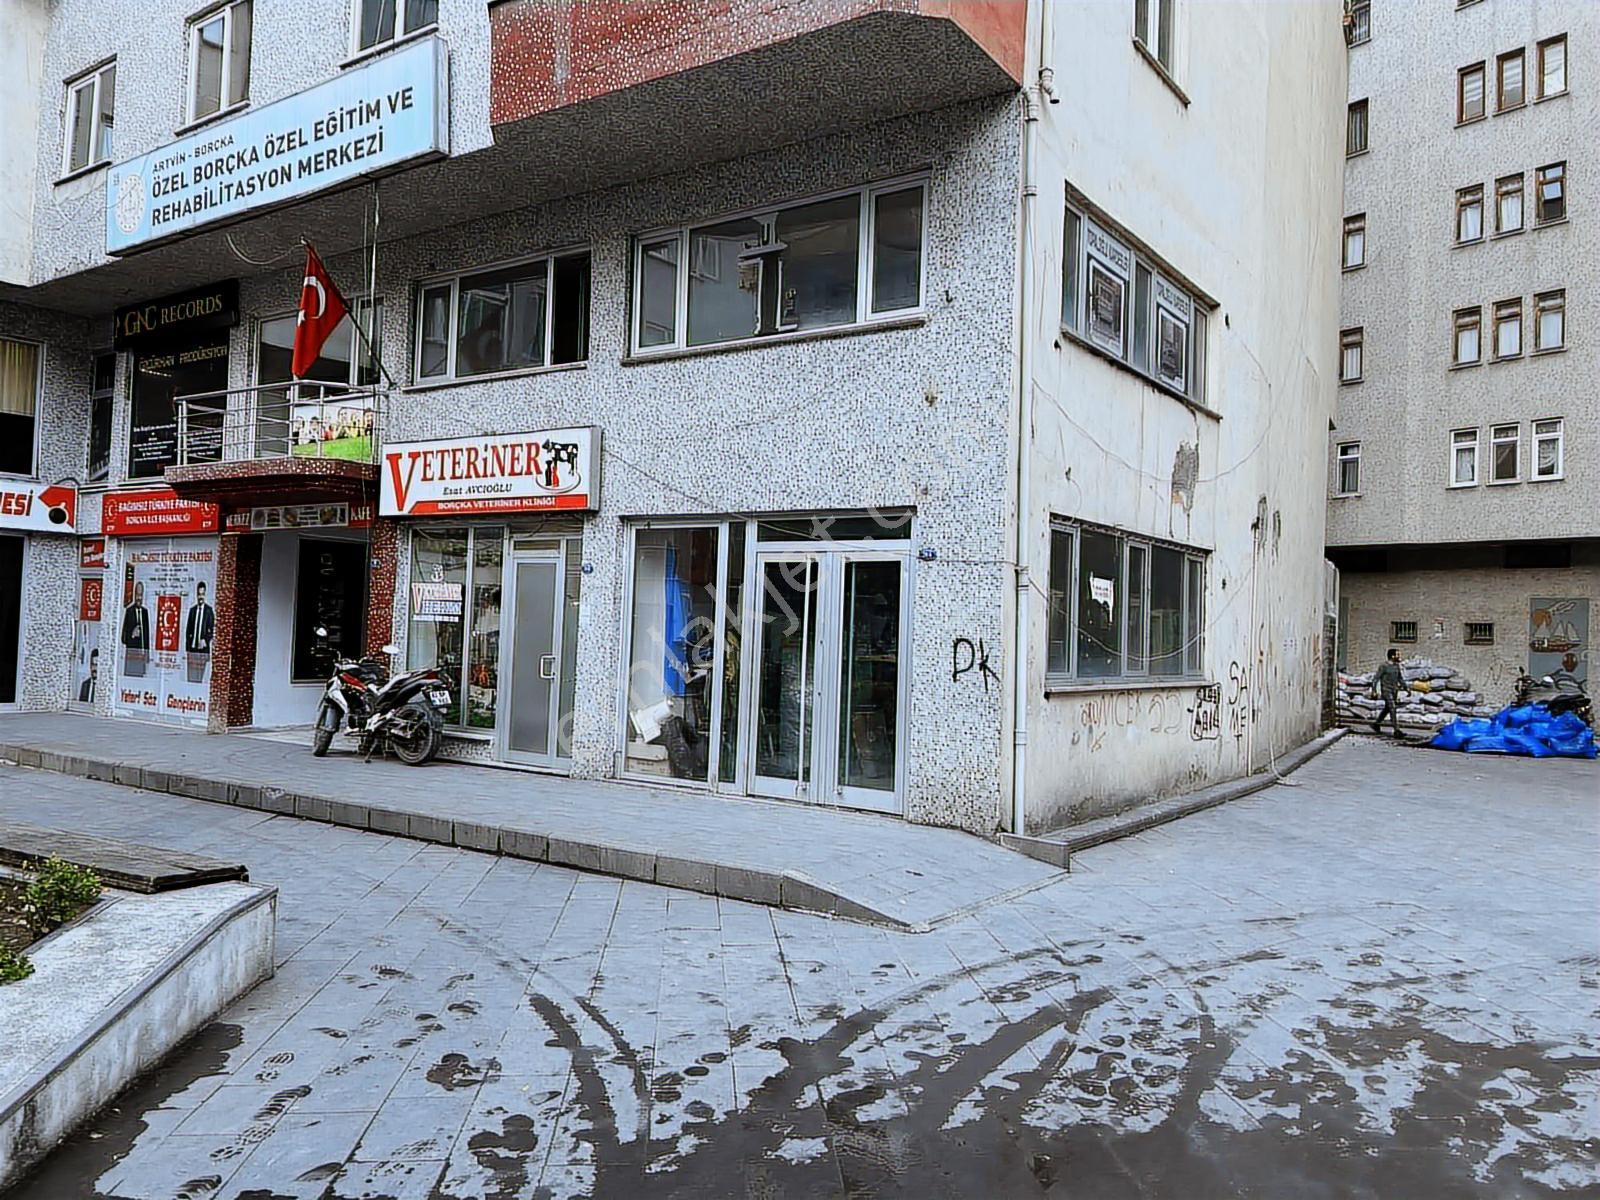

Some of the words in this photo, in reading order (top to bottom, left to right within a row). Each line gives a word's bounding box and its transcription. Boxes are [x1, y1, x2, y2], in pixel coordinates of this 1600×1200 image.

[152, 171, 189, 198] ÖZEL
[193, 145, 260, 184] BORÇKA
[264, 133, 308, 159] ÖZEL
[313, 98, 381, 142] EĞİTİM
[387, 86, 413, 114] VE
[152, 151, 186, 175] ARTVİN
[194, 134, 234, 158] BORÇKA
[152, 163, 292, 226] REHABİLİTASYON
[297, 125, 384, 179] MERKEZİ
[161, 294, 222, 325] RECORDS
[443, 486, 463, 496] Esat
[465, 482, 513, 496] AVCIOĞLU
[0, 489, 34, 516] ESİ
[350, 506, 371, 520] KAFE
[437, 501, 473, 510] BORÇKA
[474, 499, 522, 508] VETERİNER
[522, 497, 556, 507] KLİNİĞİ
[143, 691, 157, 706] Söz
[166, 693, 206, 713] Gençlerin
